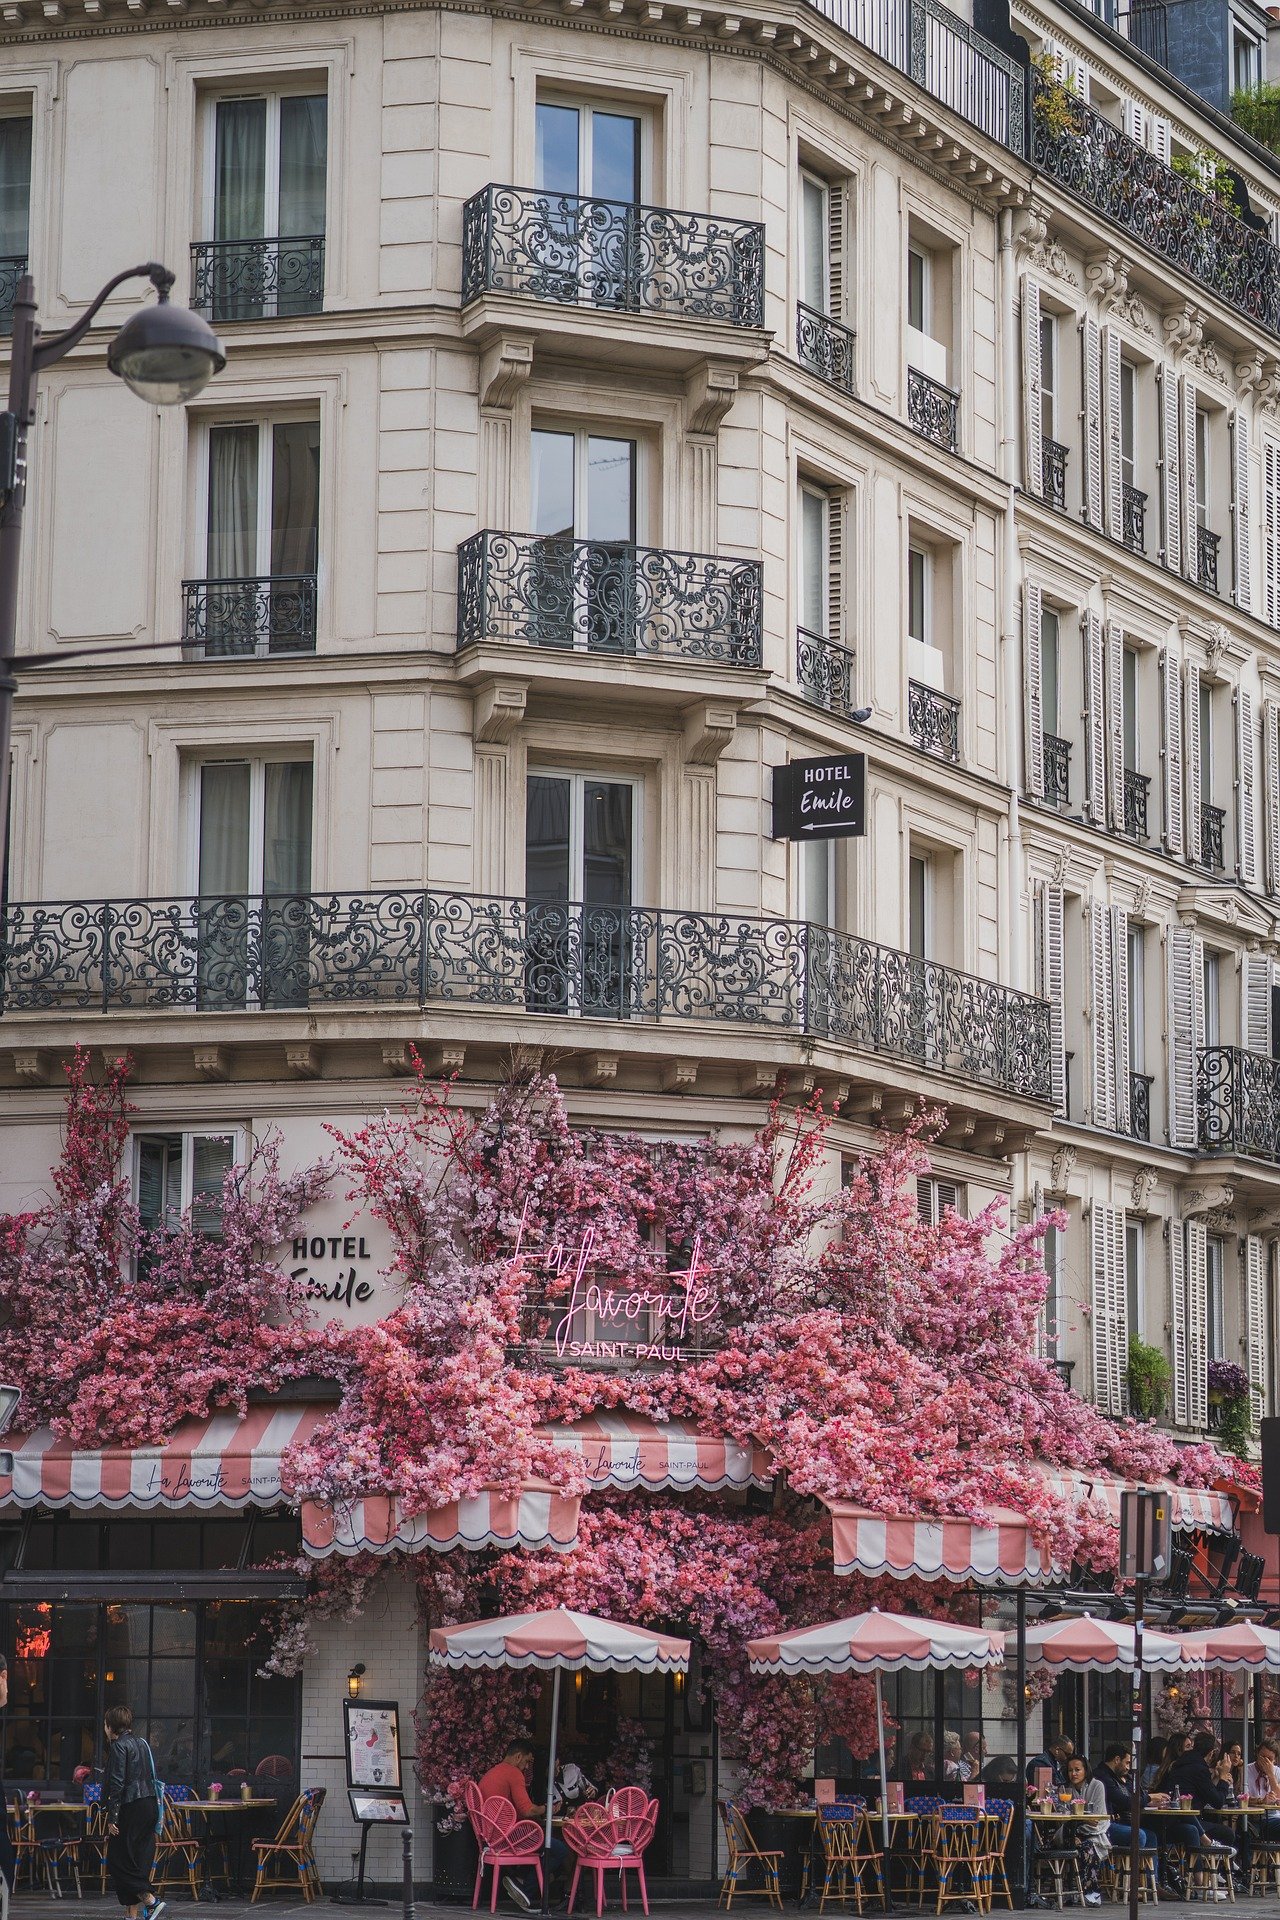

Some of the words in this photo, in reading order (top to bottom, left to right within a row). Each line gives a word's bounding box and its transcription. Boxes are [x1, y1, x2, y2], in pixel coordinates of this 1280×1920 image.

[804, 766, 852, 783] HOTEL
[800, 788, 854, 814] Emile
[292, 1236, 371, 1259] HOTEL
[504, 1194, 574, 1277] La
[569, 1341, 688, 1362] SAINT-PAUL
[592, 1445, 647, 1479] favorite
[658, 1461, 709, 1470] SAINT-PAUL
[146, 1464, 172, 1492] La
[172, 1463, 229, 1498] favorite
[241, 1476, 290, 1485] SAINT-PAU
